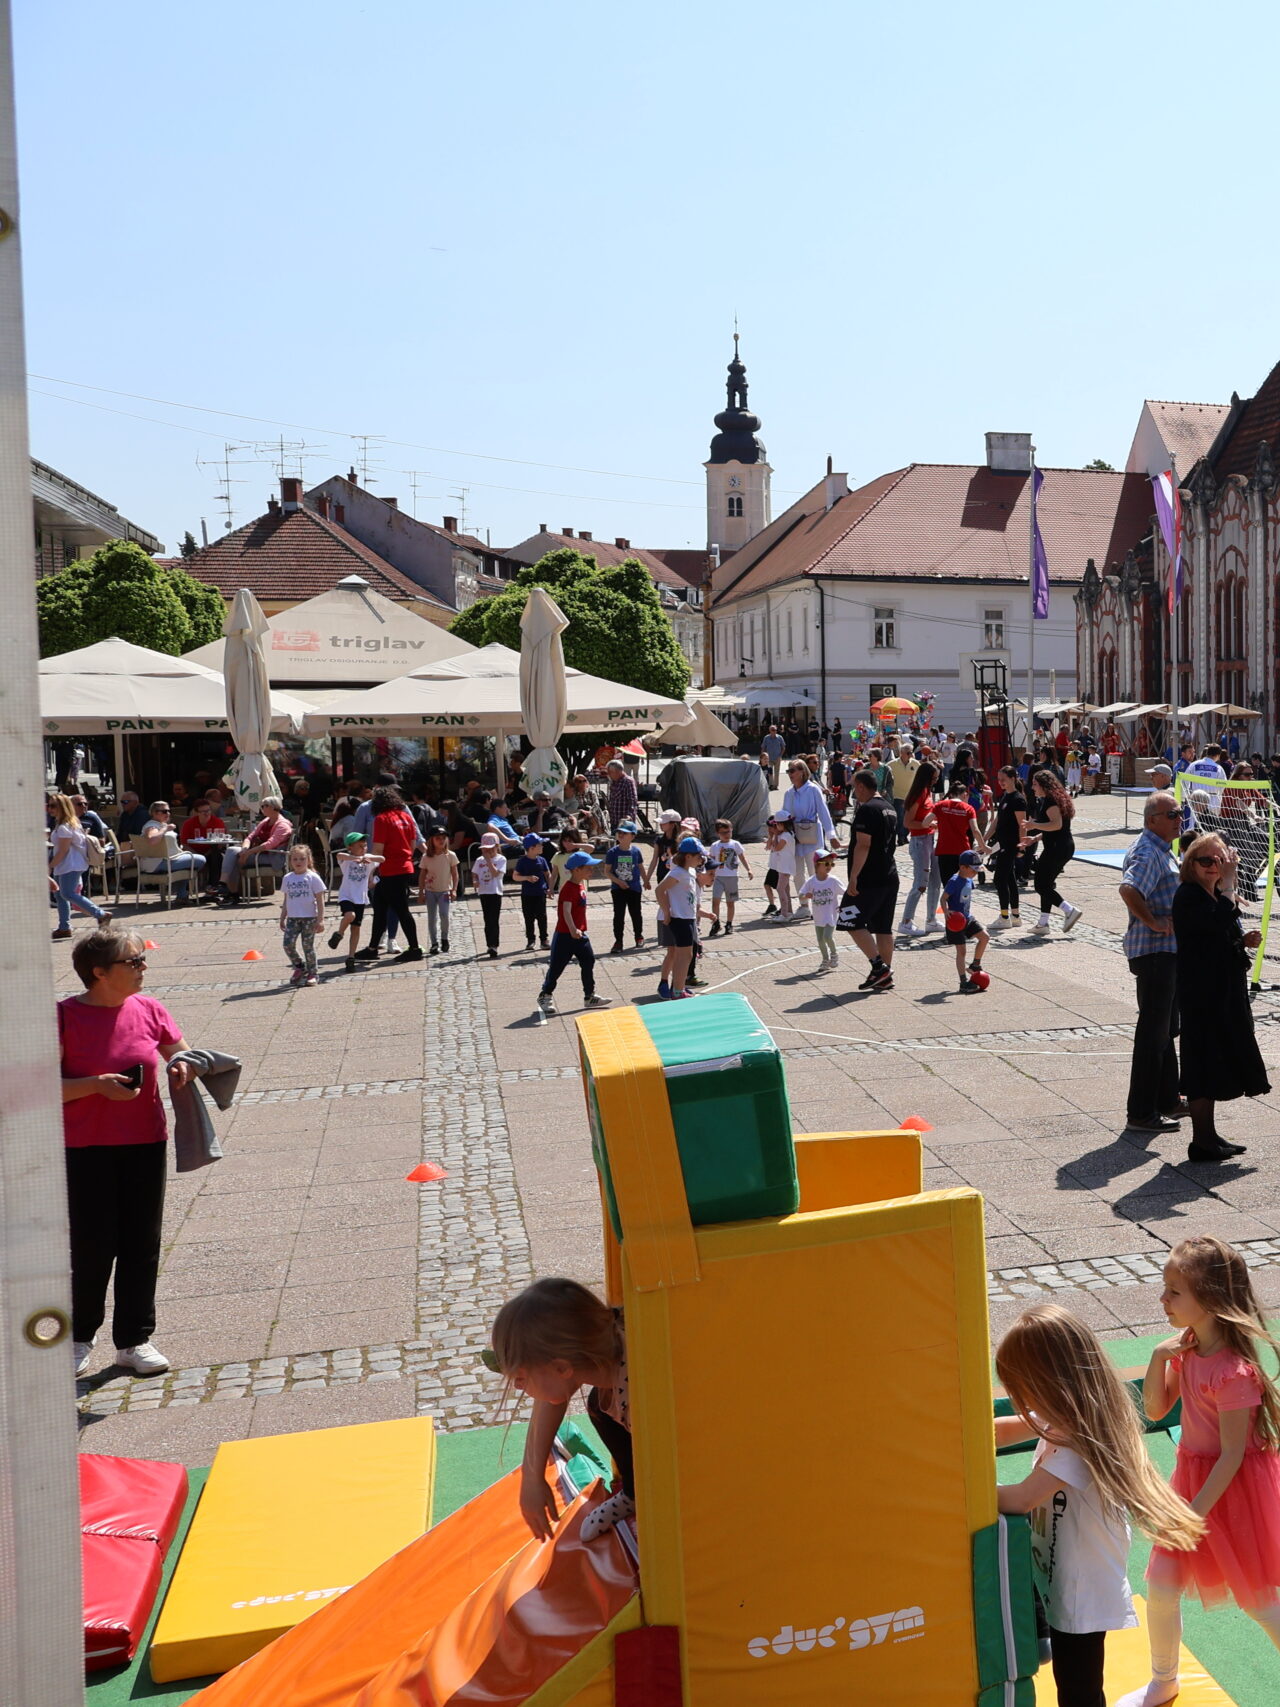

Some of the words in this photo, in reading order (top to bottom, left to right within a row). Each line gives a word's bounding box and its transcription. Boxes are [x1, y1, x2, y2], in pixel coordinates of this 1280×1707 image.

[329, 635, 426, 652] triglav
[608, 708, 648, 721] PAN
[106, 719, 154, 730] PAN
[204, 719, 229, 729] PA
[330, 717, 374, 726] PAN
[421, 715, 465, 726] PAN
[1048, 1490, 1067, 1587] Champion
